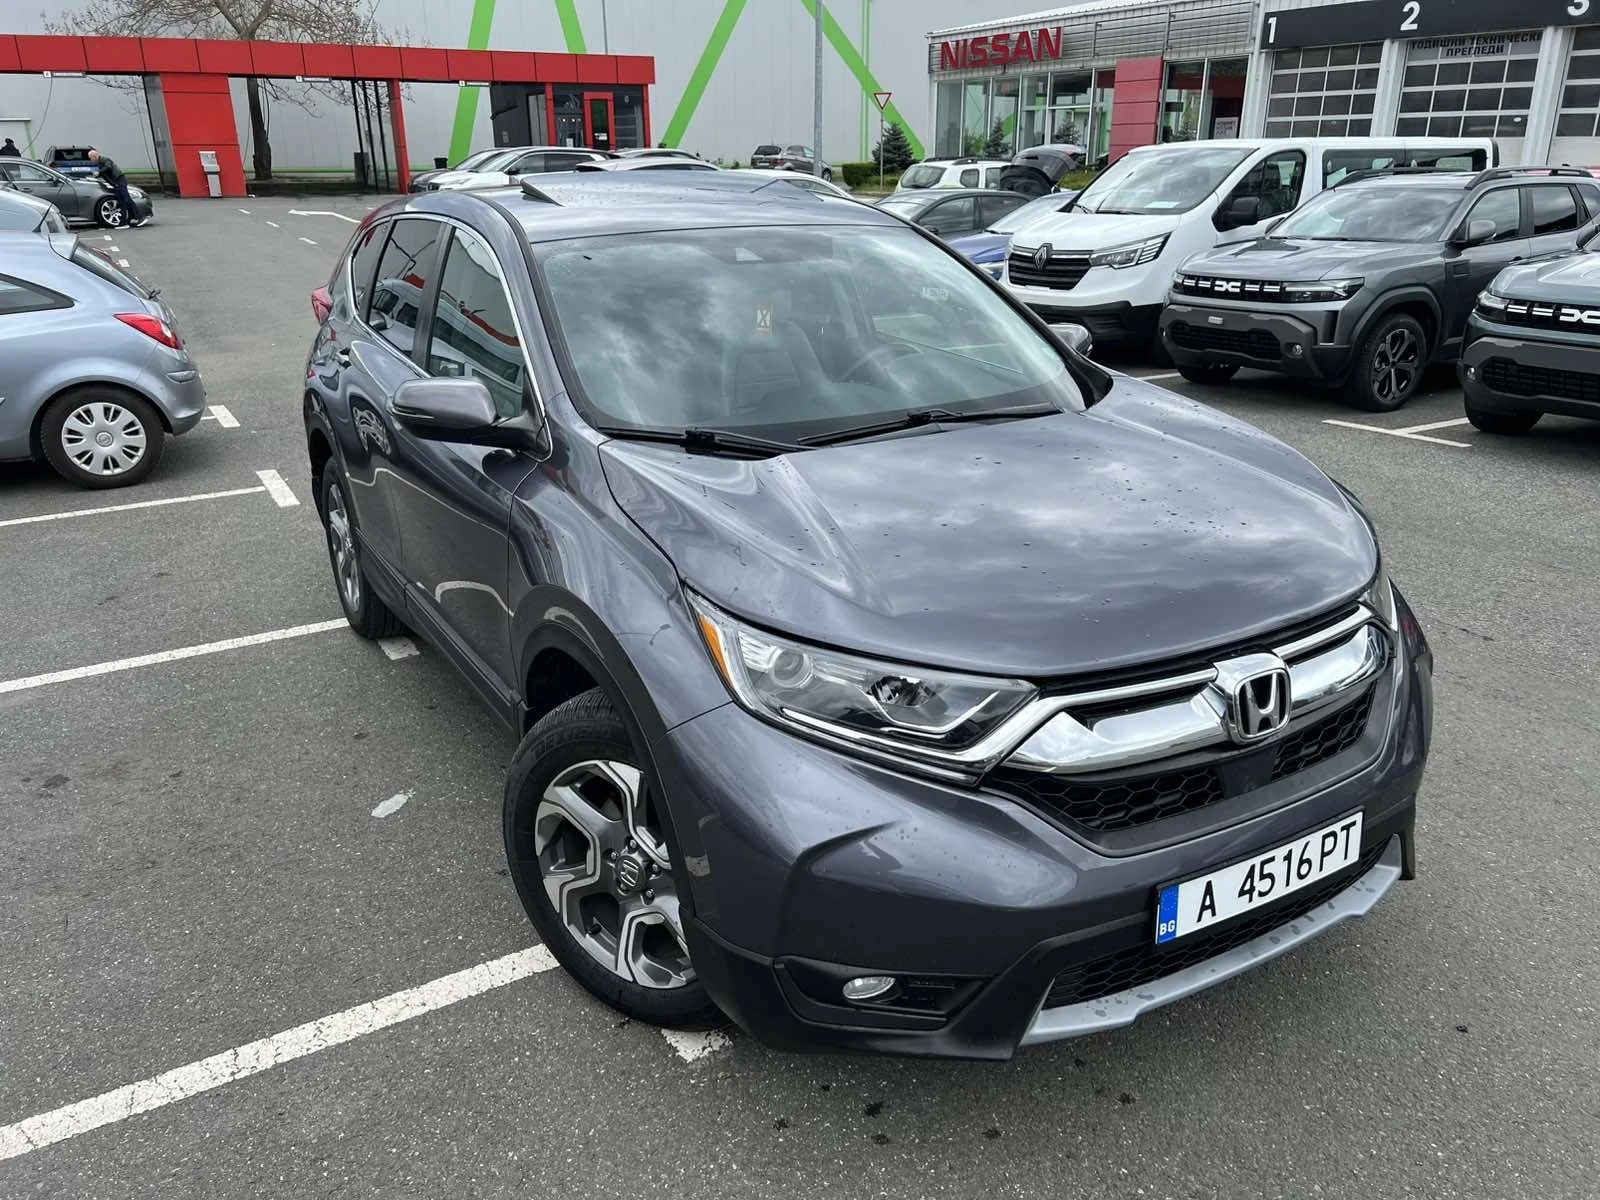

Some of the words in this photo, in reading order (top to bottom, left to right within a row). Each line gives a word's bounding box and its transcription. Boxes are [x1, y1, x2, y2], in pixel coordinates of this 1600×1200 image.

[1267, 16, 1277, 44] 1
[1400, 1, 1421, 31] 2
[940, 26, 1064, 71] NISSAN
[1446, 44, 1505, 57] ПРЕГЛЕДИ
[1196, 880, 1217, 923] A
[1238, 841, 1312, 903] 4516
[1319, 820, 1357, 872] PT
[1159, 919, 1176, 934] BG
